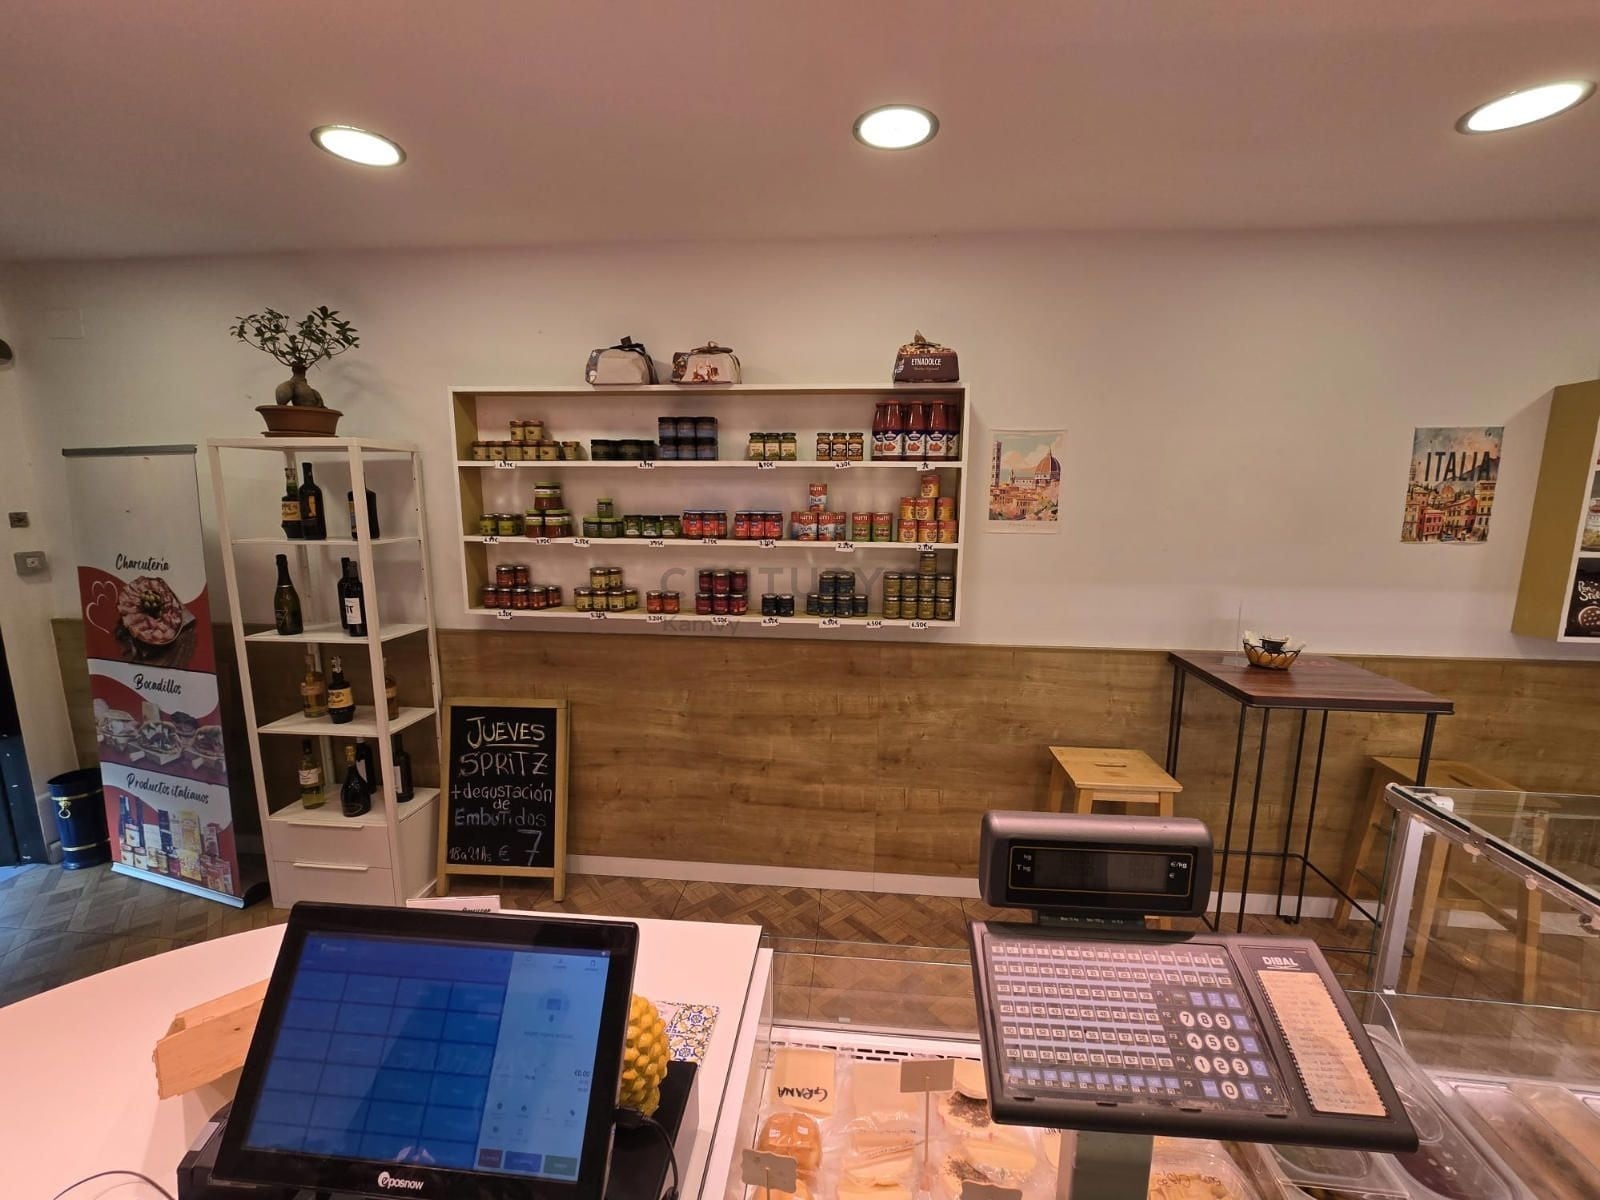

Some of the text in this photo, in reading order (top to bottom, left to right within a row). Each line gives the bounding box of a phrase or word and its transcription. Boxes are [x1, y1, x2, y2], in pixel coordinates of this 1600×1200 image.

[1424, 452, 1490, 482] ITALIA
[134, 673, 181, 694] Bocadillos
[466, 716, 546, 748] JUEVES
[126, 773, 170, 795] Productos
[493, 798, 510, 810] de
[518, 829, 542, 866] 7
[1262, 956, 1299, 966] DIBAL
